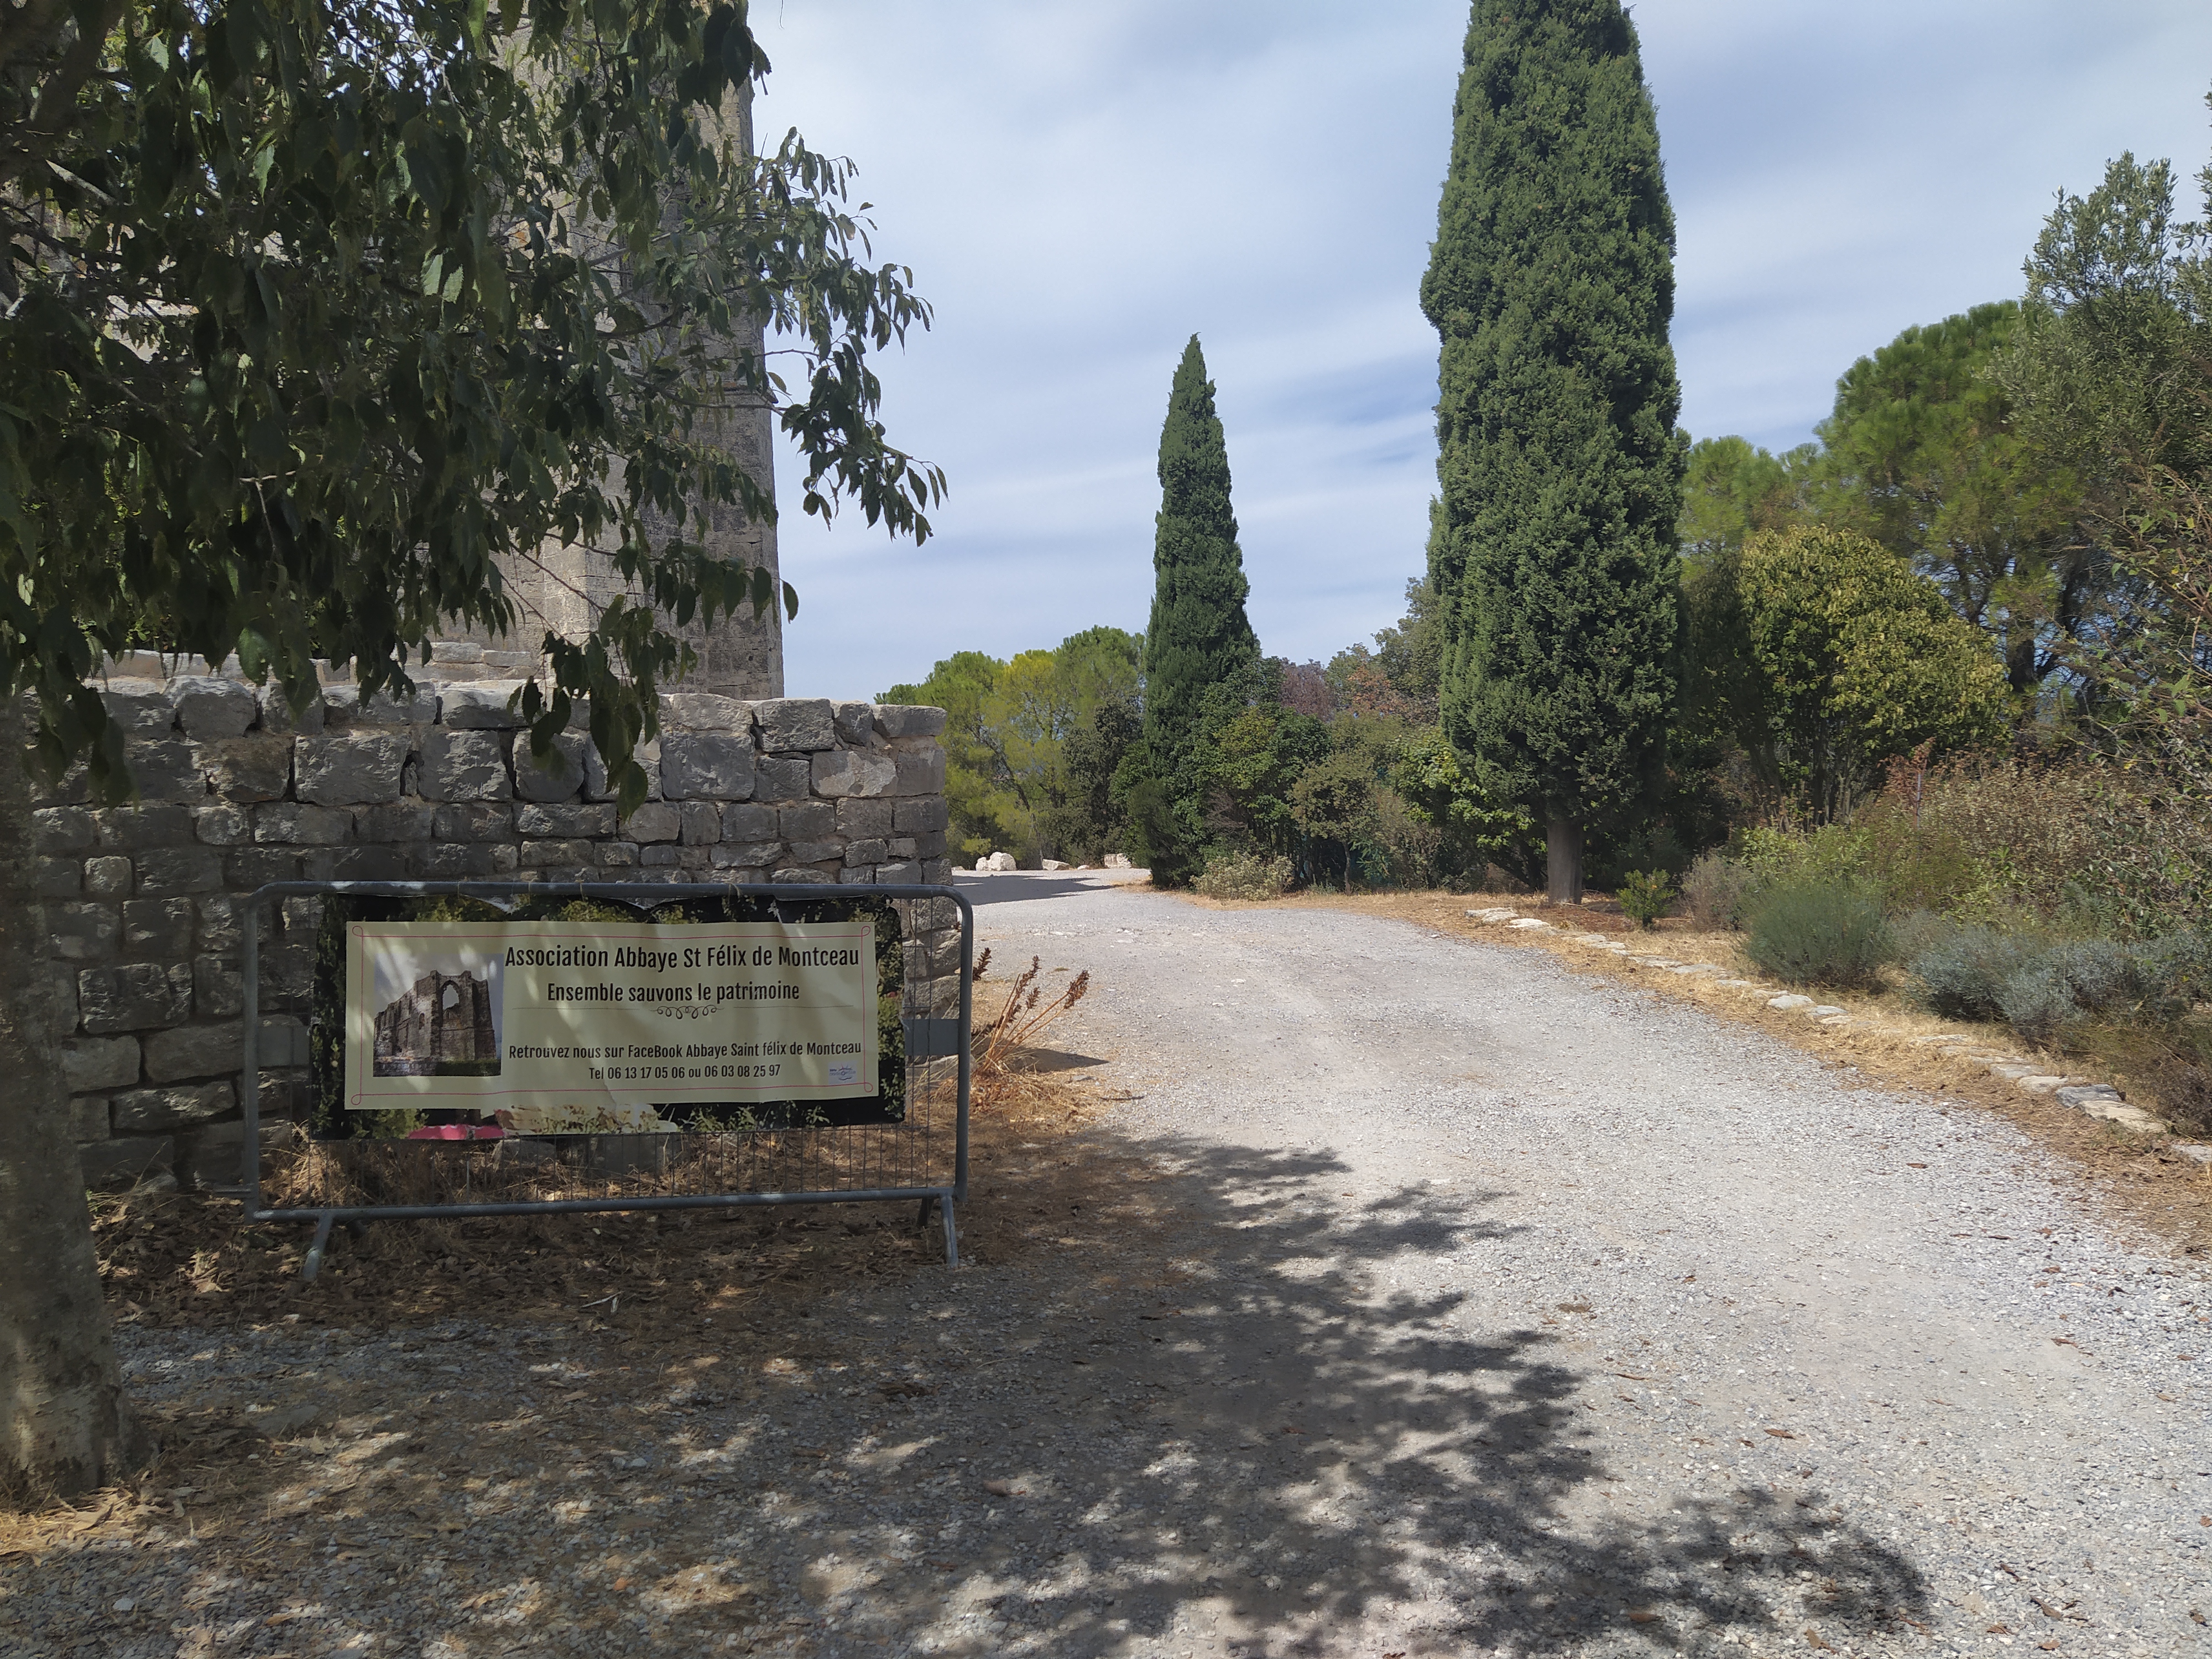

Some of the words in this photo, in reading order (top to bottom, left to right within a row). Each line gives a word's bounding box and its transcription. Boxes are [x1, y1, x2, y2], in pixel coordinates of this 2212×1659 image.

[504, 944, 608, 967] Association
[614, 946, 677, 973] Abbaye
[684, 947, 702, 968] St
[707, 944, 747, 967] Félix
[752, 945, 773, 967] de
[778, 946, 859, 967] Montceau
[547, 982, 623, 1001] Ensemble
[628, 987, 692, 1002] sauvons
[698, 982, 711, 1001] le
[717, 980, 800, 1005] patrimoine
[509, 1045, 570, 1059] Retrouvez
[573, 1047, 601, 1058] nous
[604, 1047, 625, 1058] sur
[628, 1044, 683, 1058] FaceBook
[686, 1043, 728, 1060] Abbaye
[731, 1042, 760, 1057] Saint
[762, 1041, 787, 1056] félix
[789, 1041, 803, 1055] de
[806, 1042, 862, 1056] Montceau
[588, 1067, 604, 1079] Tel
[607, 1067, 622, 1079] 06
[624, 1066, 637, 1079] 13
[640, 1066, 652, 1079] 17
[654, 1066, 668, 1079] 05
[671, 1066, 685, 1079] 06
[688, 1068, 701, 1078] ou
[704, 1065, 718, 1078] 06
[721, 1065, 734, 1077] 03
[737, 1065, 750, 1078] 08
[753, 1065, 766, 1078] 25
[769, 1064, 781, 1077] 97
